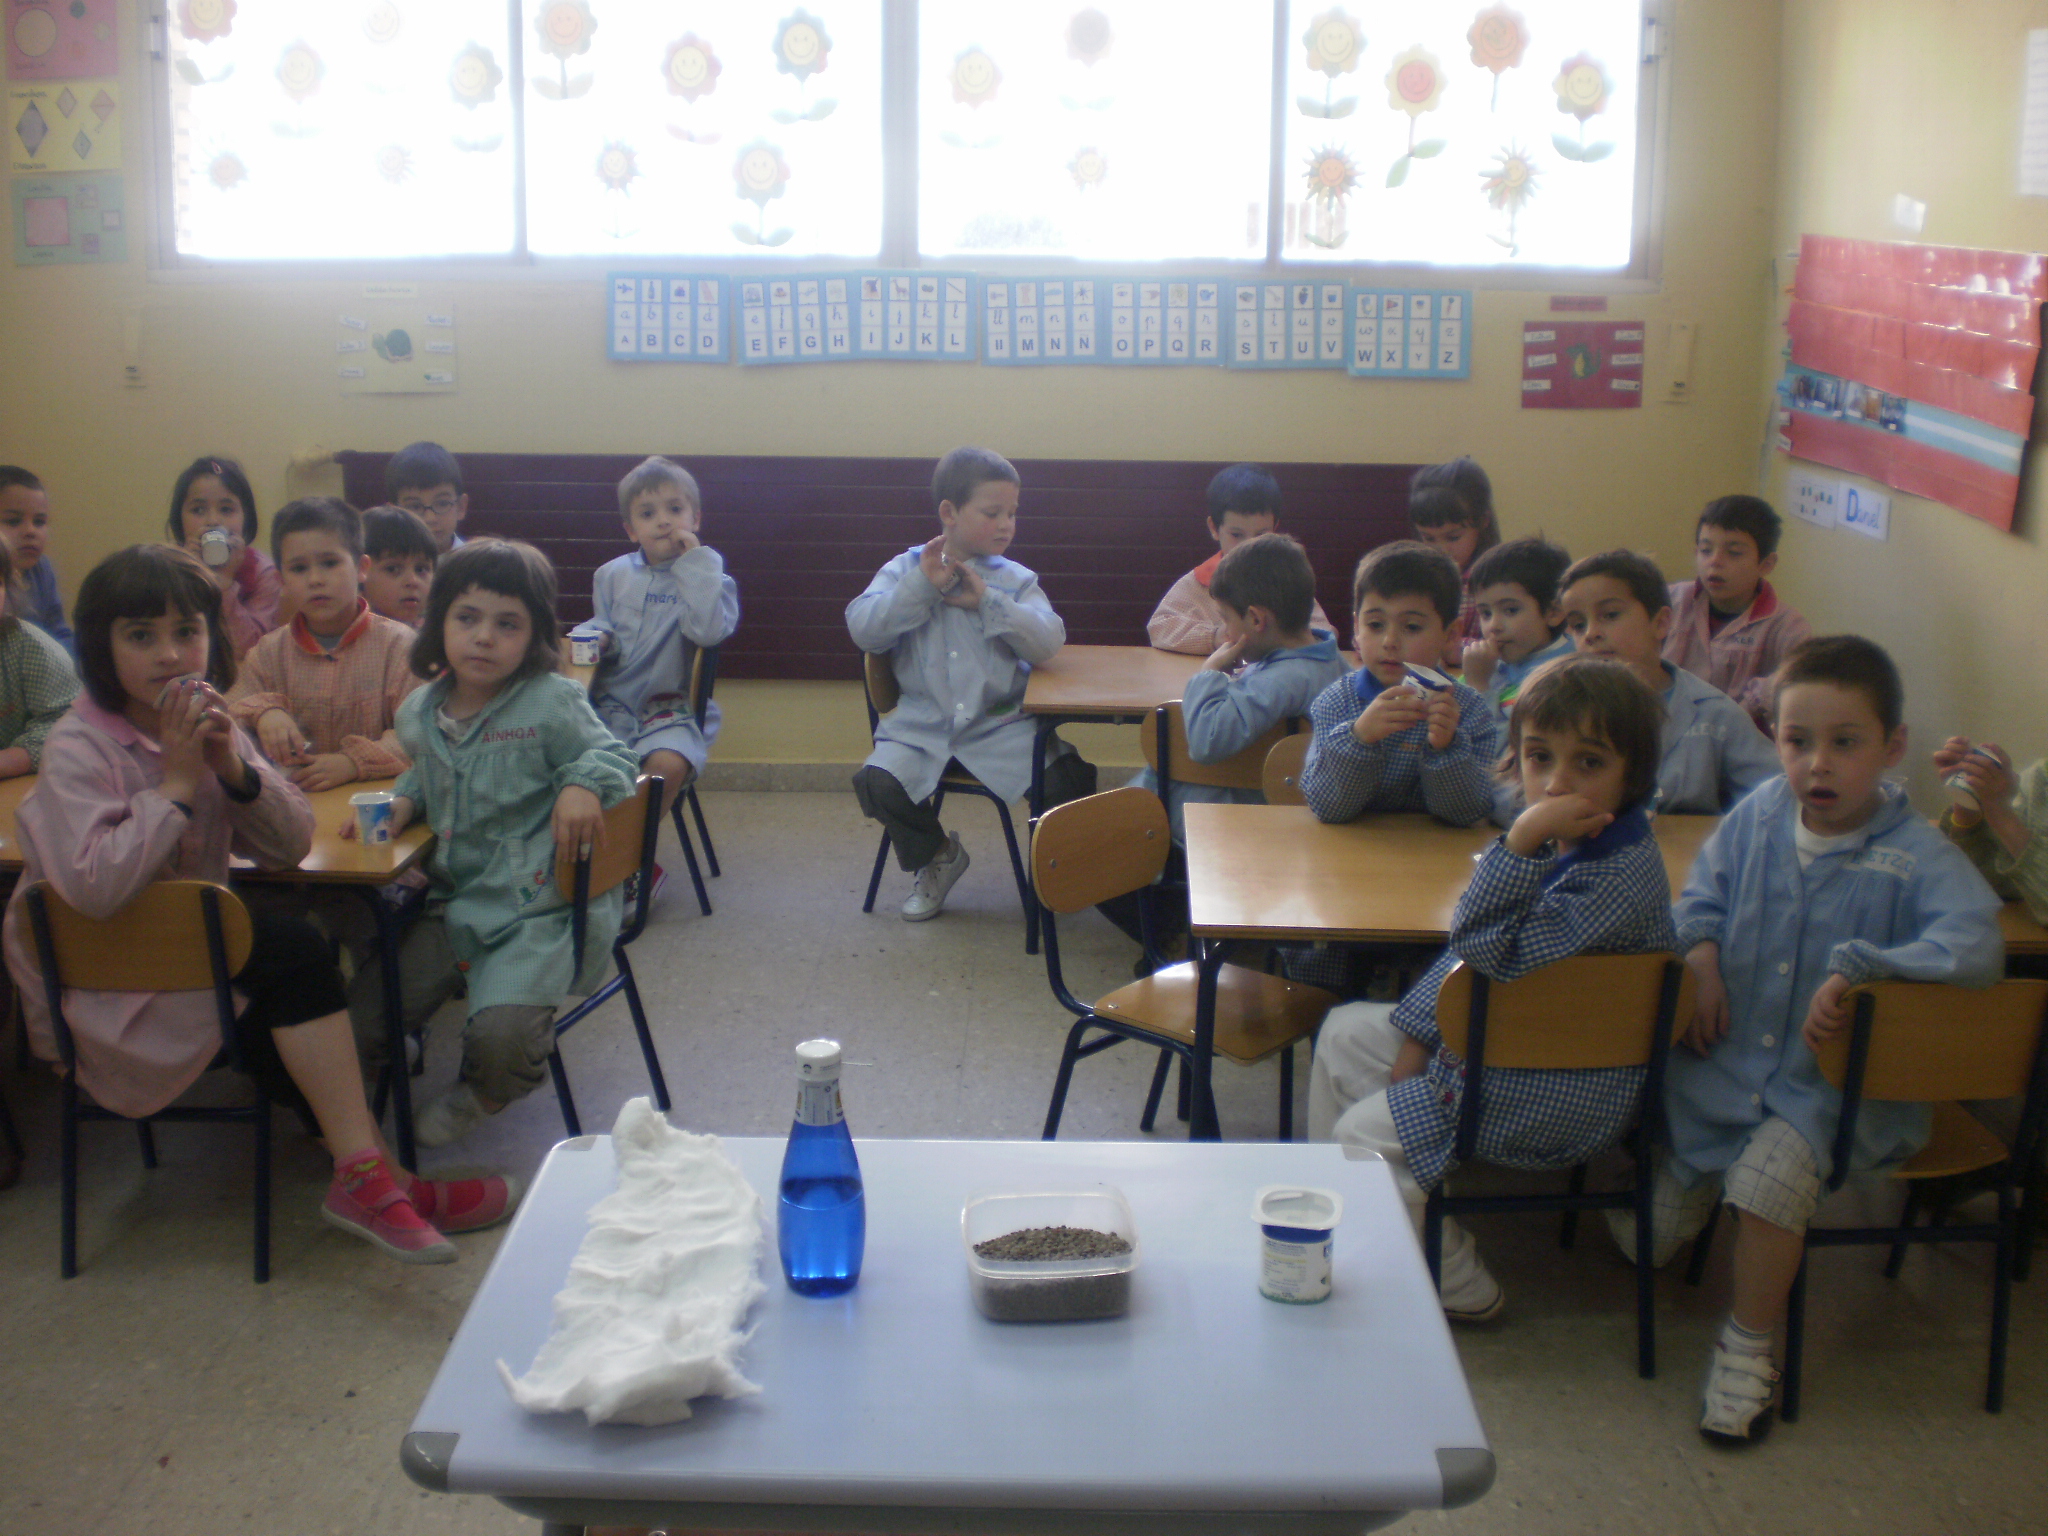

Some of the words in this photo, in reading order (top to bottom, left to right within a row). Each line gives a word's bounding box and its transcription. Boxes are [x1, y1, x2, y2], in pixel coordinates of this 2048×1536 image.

[621, 335, 629, 344] A
[647, 334, 657, 346] B
[675, 334, 685, 347] C
[703, 335, 713, 348] D
[752, 338, 761, 351] E
[779, 336, 787, 349] F
[805, 335, 817, 348] G
[833, 334, 844, 347] H
[895, 332, 903, 345] J
[921, 332, 932, 345] K
[951, 333, 960, 346] L
[1022, 338, 1034, 351] M
[1050, 337, 1061, 350] N
[1117, 339, 1128, 351] O
[1145, 339, 1154, 351] P
[1172, 339, 1183, 352] Q
[1201, 339, 1211, 351] R
[1241, 342, 1251, 355] S
[1270, 341, 1278, 353] T
[1298, 341, 1308, 353] U
[1326, 340, 1337, 353] V
[1358, 350, 1373, 362] W
[1386, 350, 1396, 362] X
[1443, 351, 1453, 363] Z
[482, 726, 537, 743] AINHOA
